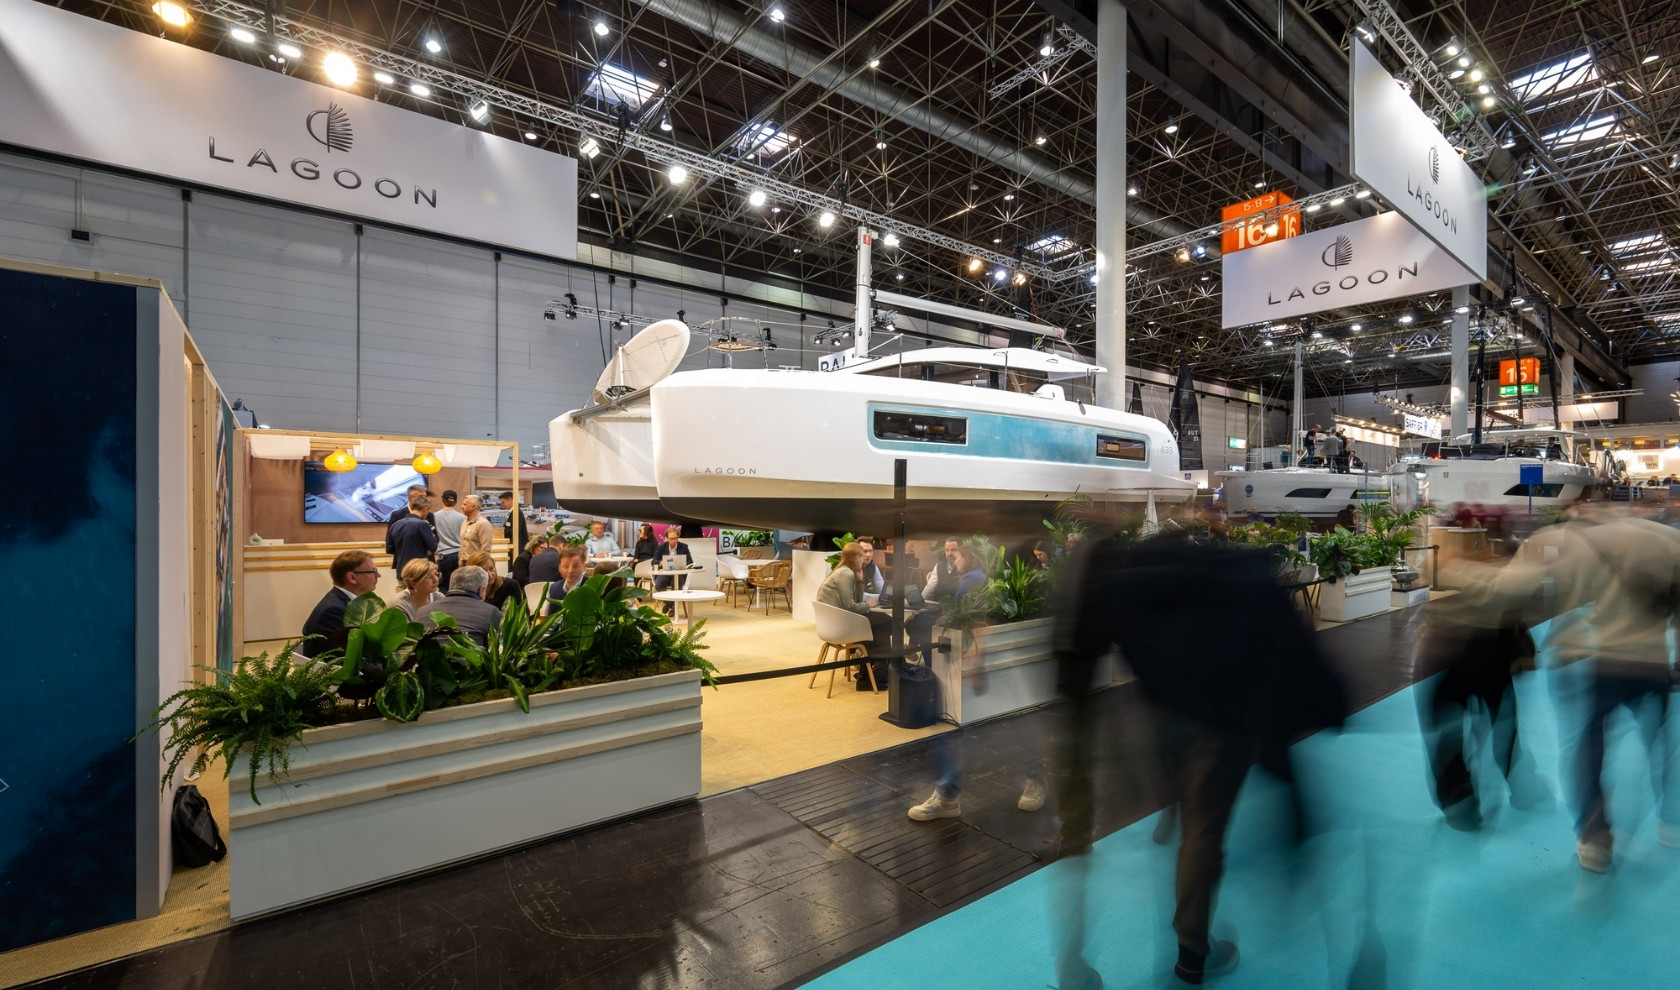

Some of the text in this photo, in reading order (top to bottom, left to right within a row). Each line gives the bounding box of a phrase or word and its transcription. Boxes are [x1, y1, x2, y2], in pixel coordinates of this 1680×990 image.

[209, 136, 437, 208] LAGOON
[1407, 172, 1457, 235] LAGOON
[1283, 214, 1297, 239] 16
[1268, 261, 1418, 305] LAGOON
[694, 467, 757, 475] LAGOON
